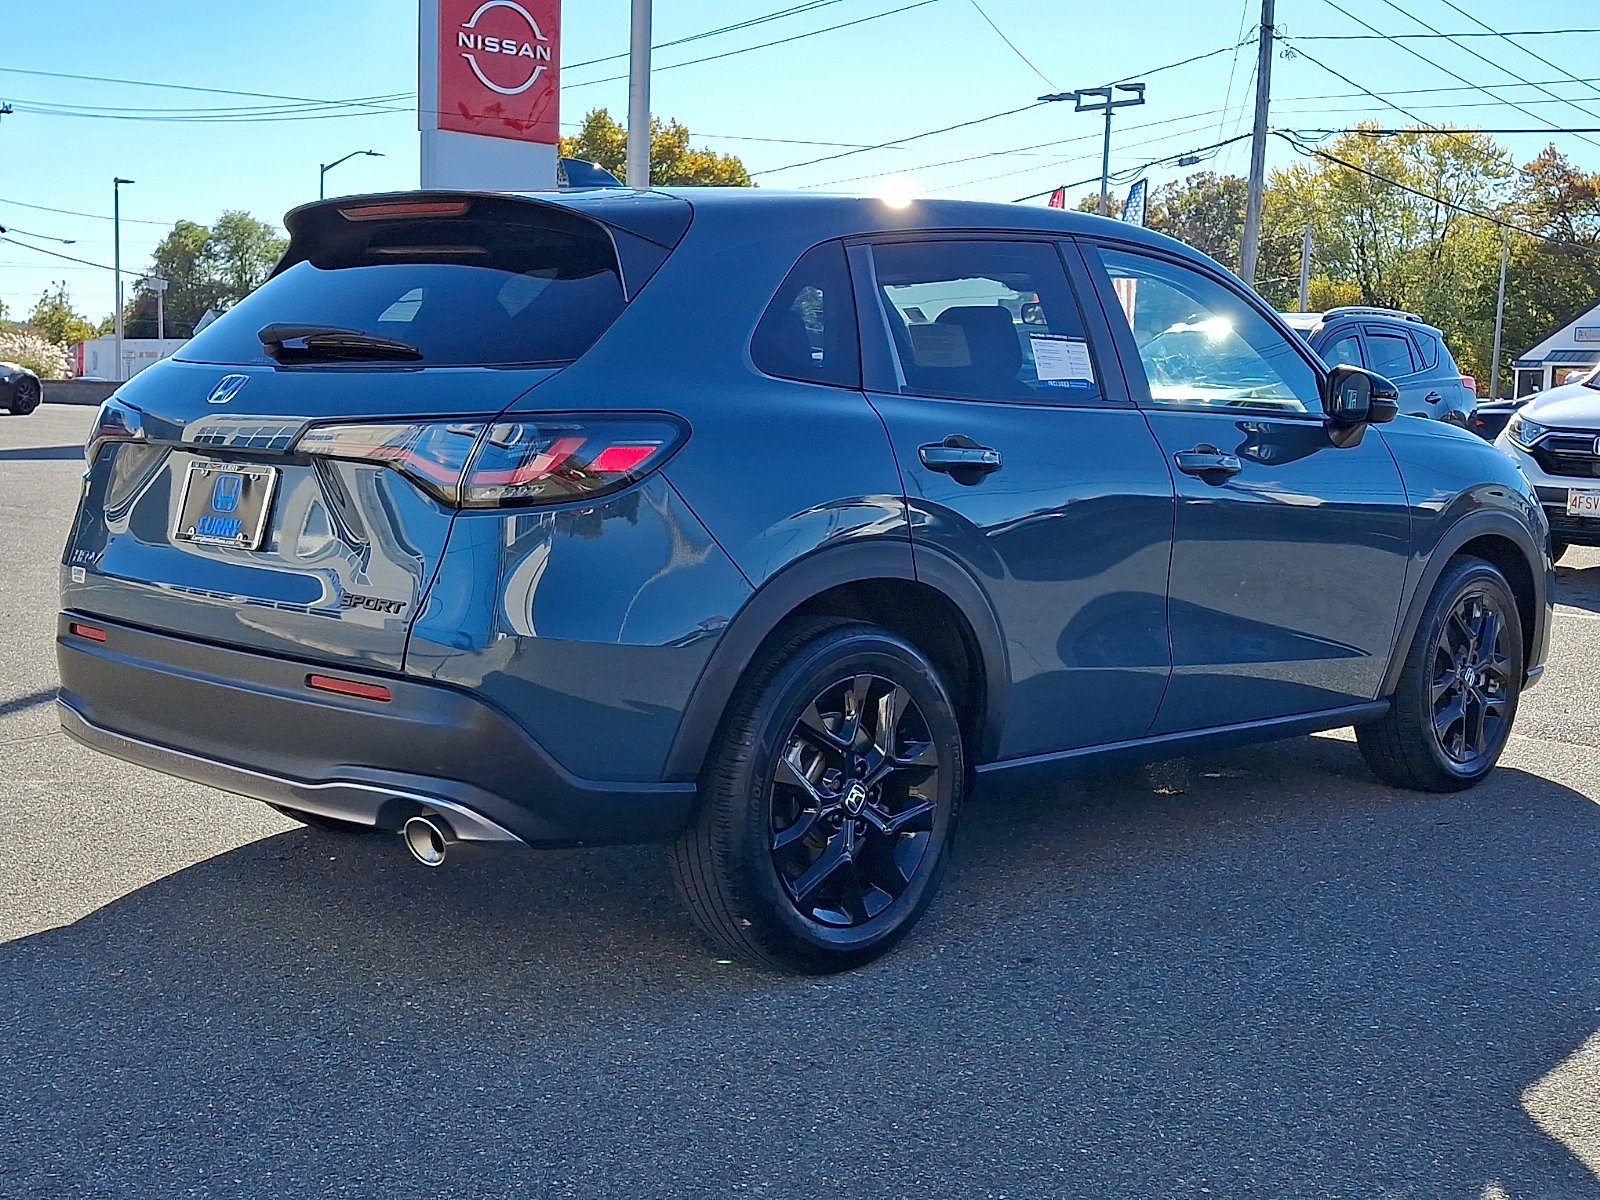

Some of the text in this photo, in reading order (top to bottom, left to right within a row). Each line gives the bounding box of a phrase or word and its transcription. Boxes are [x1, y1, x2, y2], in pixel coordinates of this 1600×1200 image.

[458, 31, 551, 61] NISSAN
[1571, 495, 1600, 511] 4FSV
[196, 515, 243, 537] CURRY
[340, 592, 407, 615] SPORT
